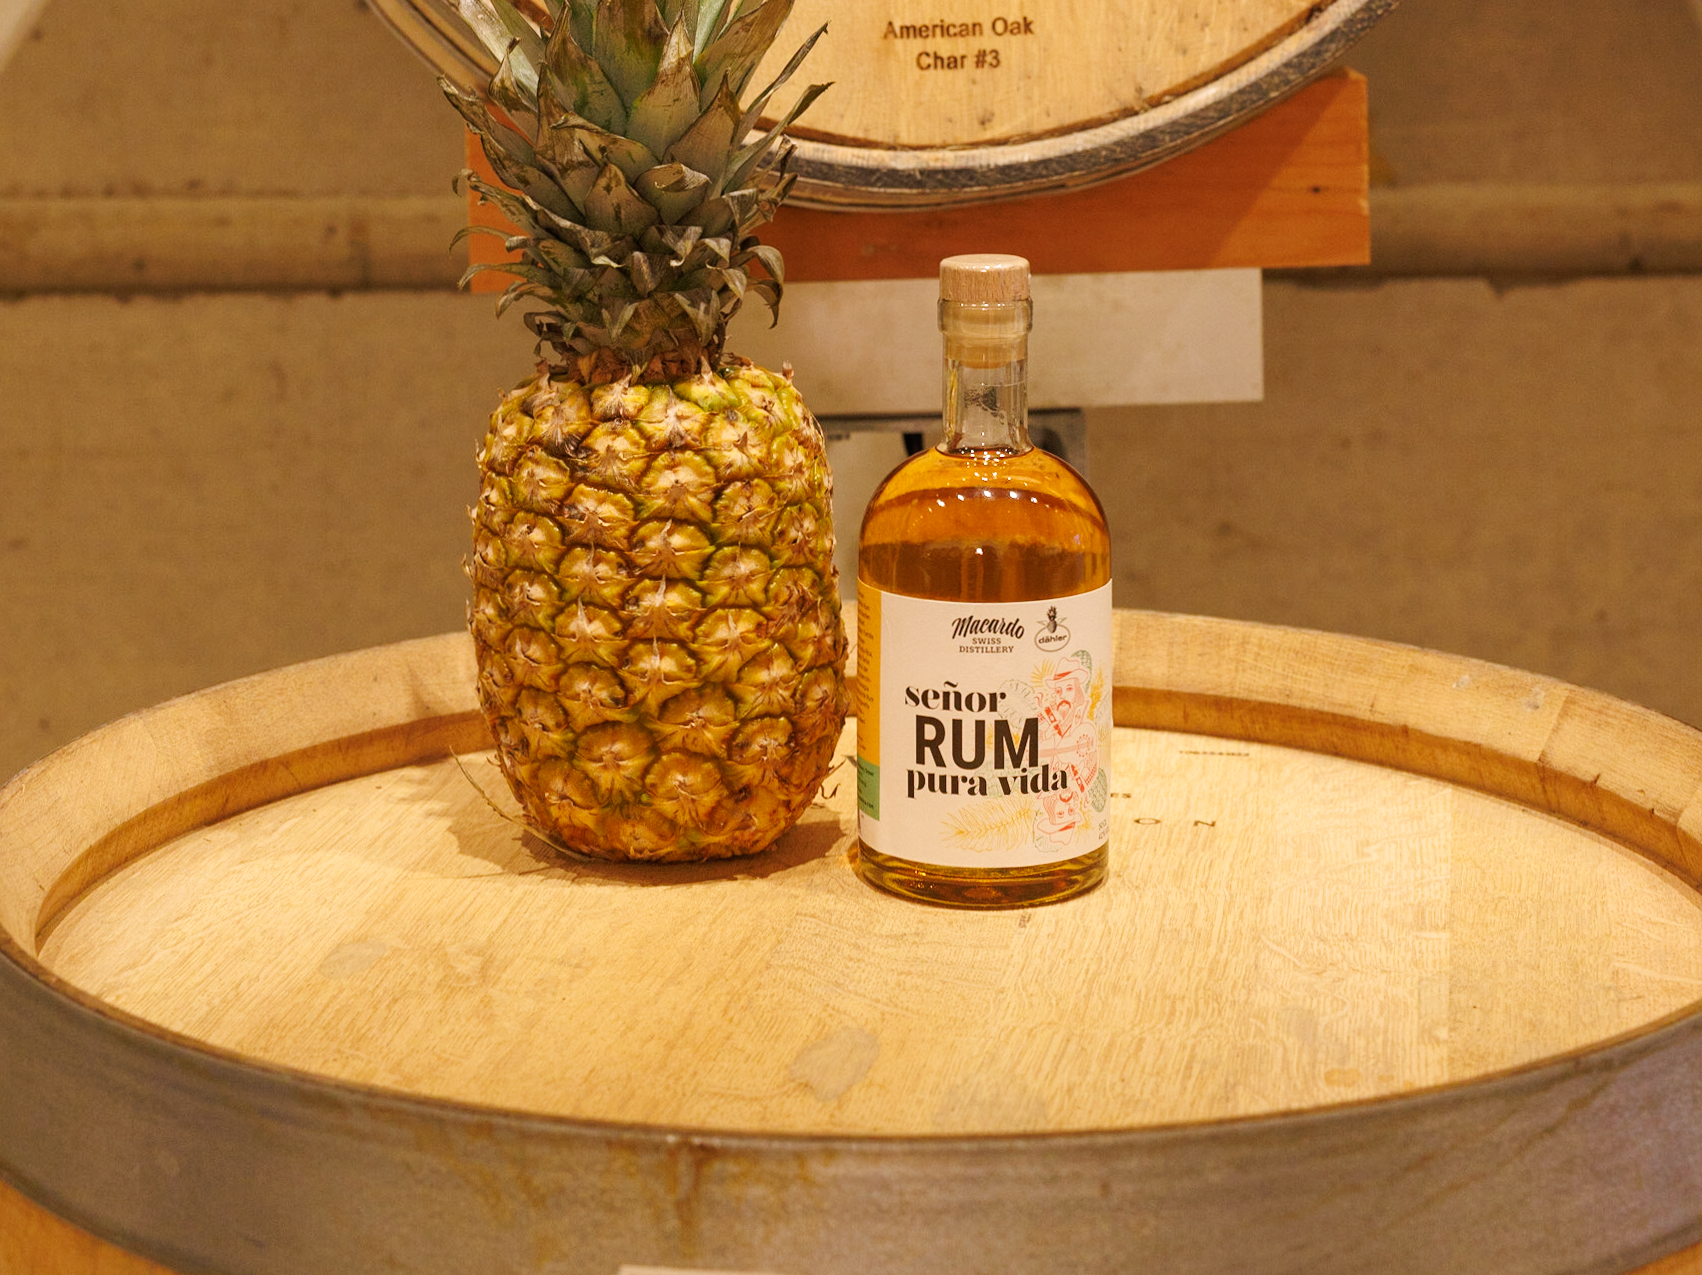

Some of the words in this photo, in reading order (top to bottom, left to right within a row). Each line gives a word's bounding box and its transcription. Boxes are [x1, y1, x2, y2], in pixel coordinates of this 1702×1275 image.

[883, 19, 983, 39] American
[991, 17, 1034, 37] Oak
[916, 51, 968, 70] Char
[975, 49, 1001, 69] #3
[951, 615, 1025, 639] Macardo
[959, 645, 1015, 654] DISTILLERY
[972, 637, 1002, 645] SWISS
[1038, 634, 1068, 645] dähler
[905, 680, 1007, 712] señor
[915, 714, 1039, 771] RUM
[906, 769, 988, 799] pura
[997, 764, 1068, 796] vida
